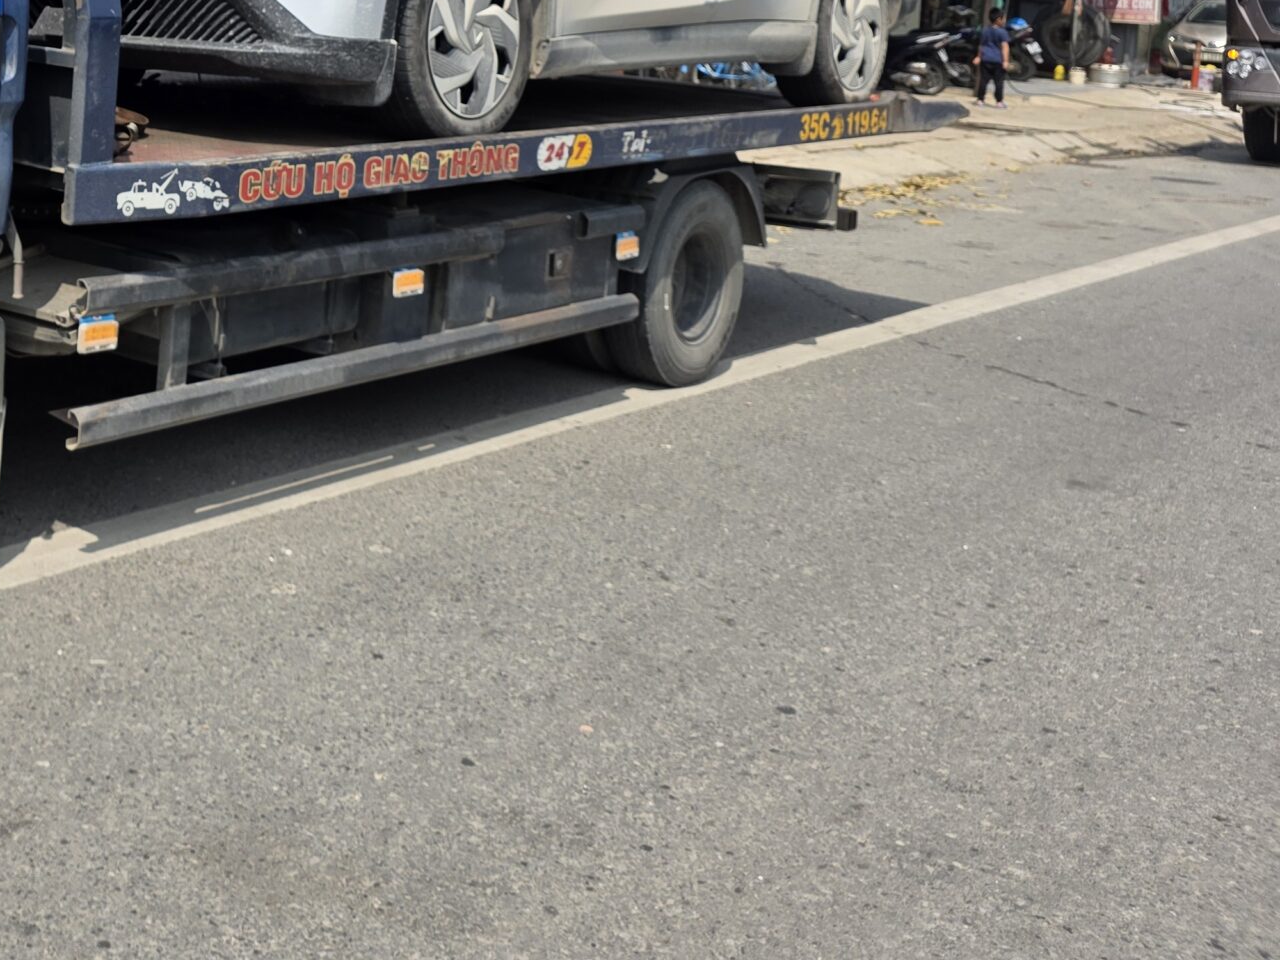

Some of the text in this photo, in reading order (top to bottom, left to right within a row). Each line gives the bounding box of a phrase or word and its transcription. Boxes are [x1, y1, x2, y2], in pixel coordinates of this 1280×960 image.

[238, 159, 307, 203] CỨU
[313, 153, 356, 199] HỘ
[363, 151, 429, 189] GIAO
[436, 141, 521, 181] THÔNG
